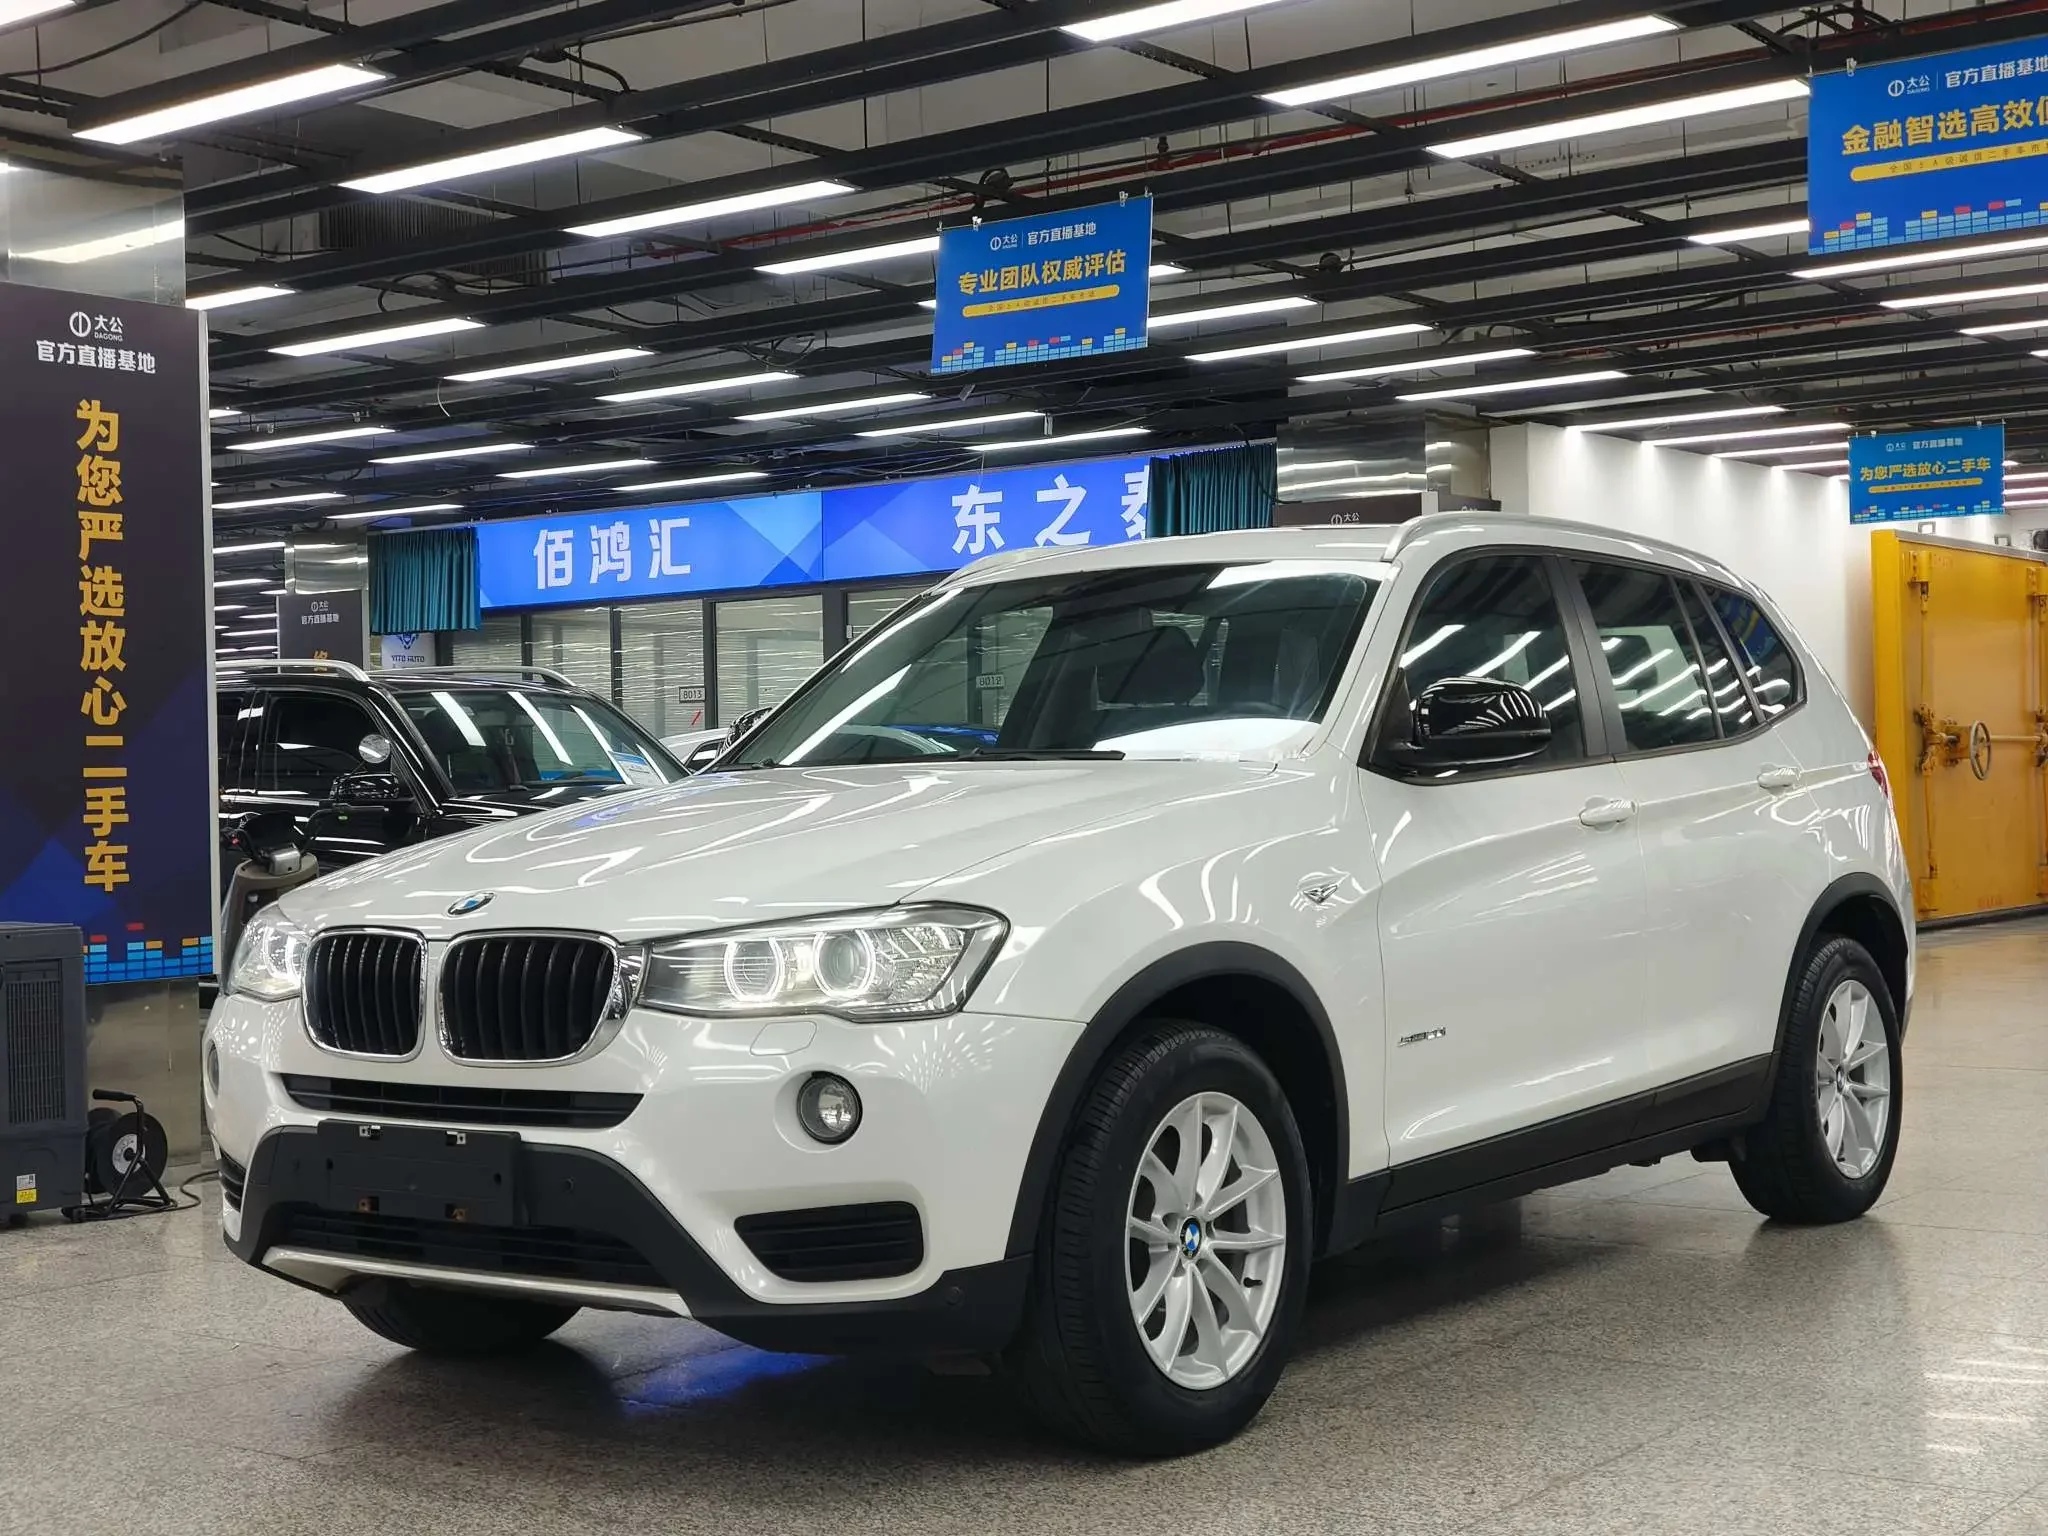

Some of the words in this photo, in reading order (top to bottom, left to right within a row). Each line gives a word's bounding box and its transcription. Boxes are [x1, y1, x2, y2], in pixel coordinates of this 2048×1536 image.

[1906, 75, 1930, 87] 大公
[1945, 55, 2048, 89] 官方直播基地
[1027, 221, 1097, 246] 官方直播基地
[958, 248, 1127, 296] 专业团队权威评估
[94, 314, 124, 334] 大公
[94, 332, 124, 342] DAGONG
[36, 339, 156, 374] 官方直播基地
[1860, 456, 1992, 482] 为您严选放心二手车
[533, 517, 692, 590] 佰鸿汇
[76, 399, 130, 893] 为您严选放心二手车
